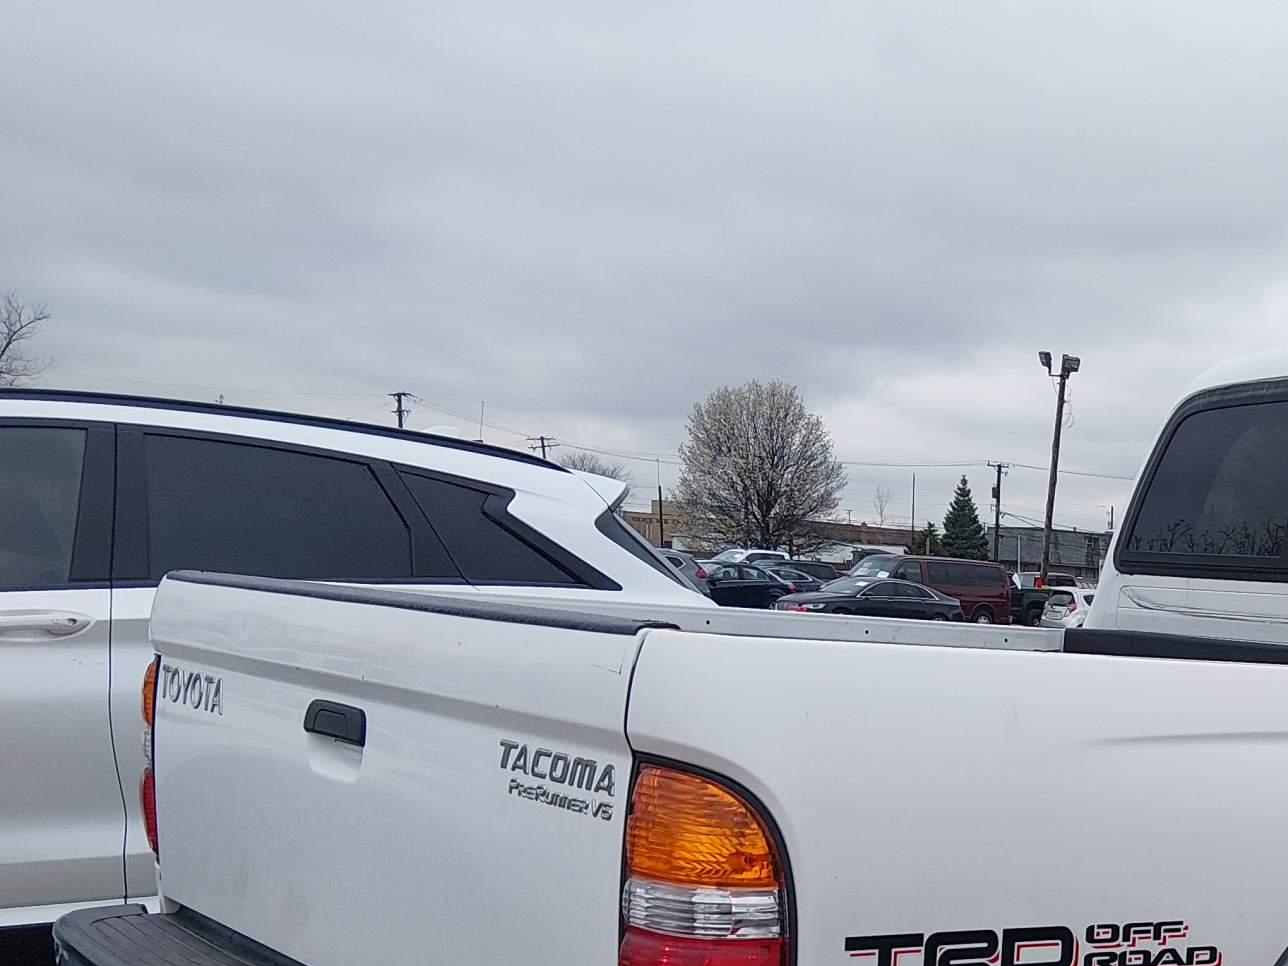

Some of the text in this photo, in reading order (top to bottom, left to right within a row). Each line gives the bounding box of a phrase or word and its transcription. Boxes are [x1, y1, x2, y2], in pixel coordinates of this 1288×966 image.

[162, 664, 223, 716] TOYOTA
[499, 739, 616, 797] TACOMA
[590, 799, 613, 821] V6
[1086, 920, 1189, 949] OFF
